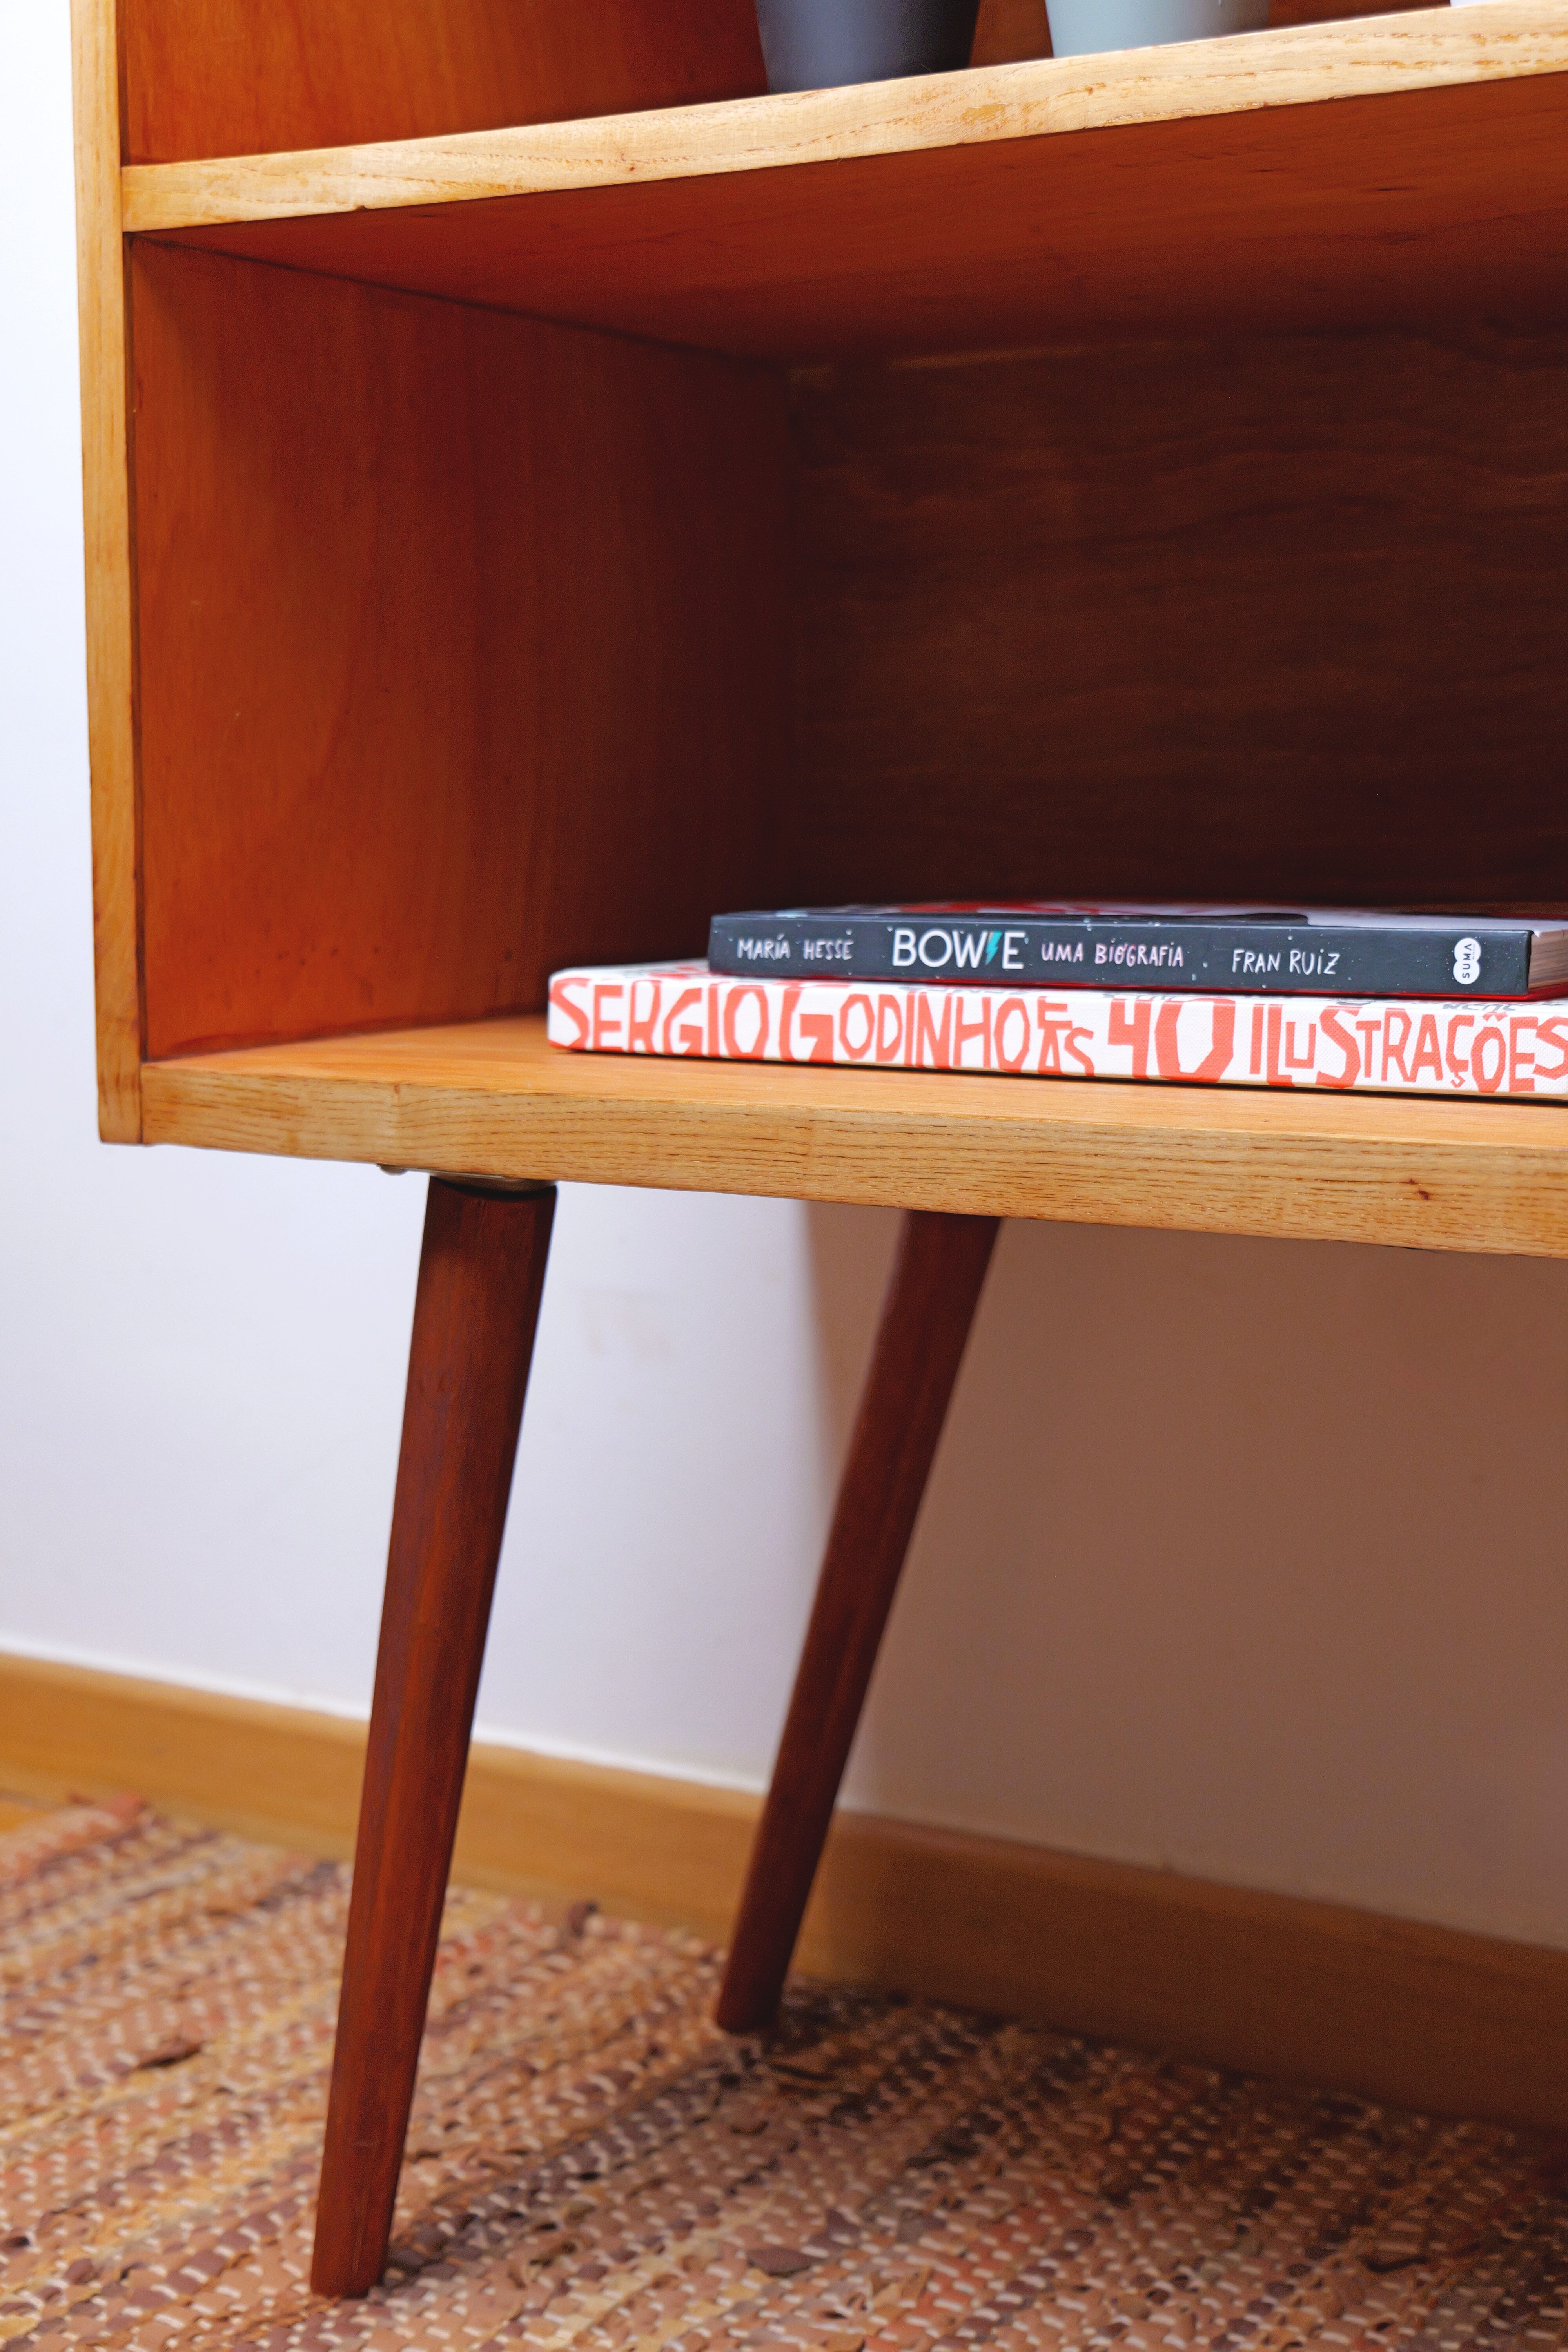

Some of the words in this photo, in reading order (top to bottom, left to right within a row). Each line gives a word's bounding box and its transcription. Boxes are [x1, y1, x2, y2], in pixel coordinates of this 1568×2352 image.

[737, 933, 791, 960] MARÍA
[804, 939, 854, 960] HESSE
[1041, 942, 1084, 963] UMA
[1094, 938, 1184, 967] BIOGRAFIA
[1232, 948, 1281, 973] FRAN
[1289, 947, 1341, 975] RUIZ
[1462, 943, 1472, 979] SUMA
[548, 978, 769, 1061] SERGIO
[778, 981, 1031, 1073] GODINHO
[1107, 998, 1236, 1083] 40
[1249, 1004, 1568, 1094] ILUSTRAÇÕES
